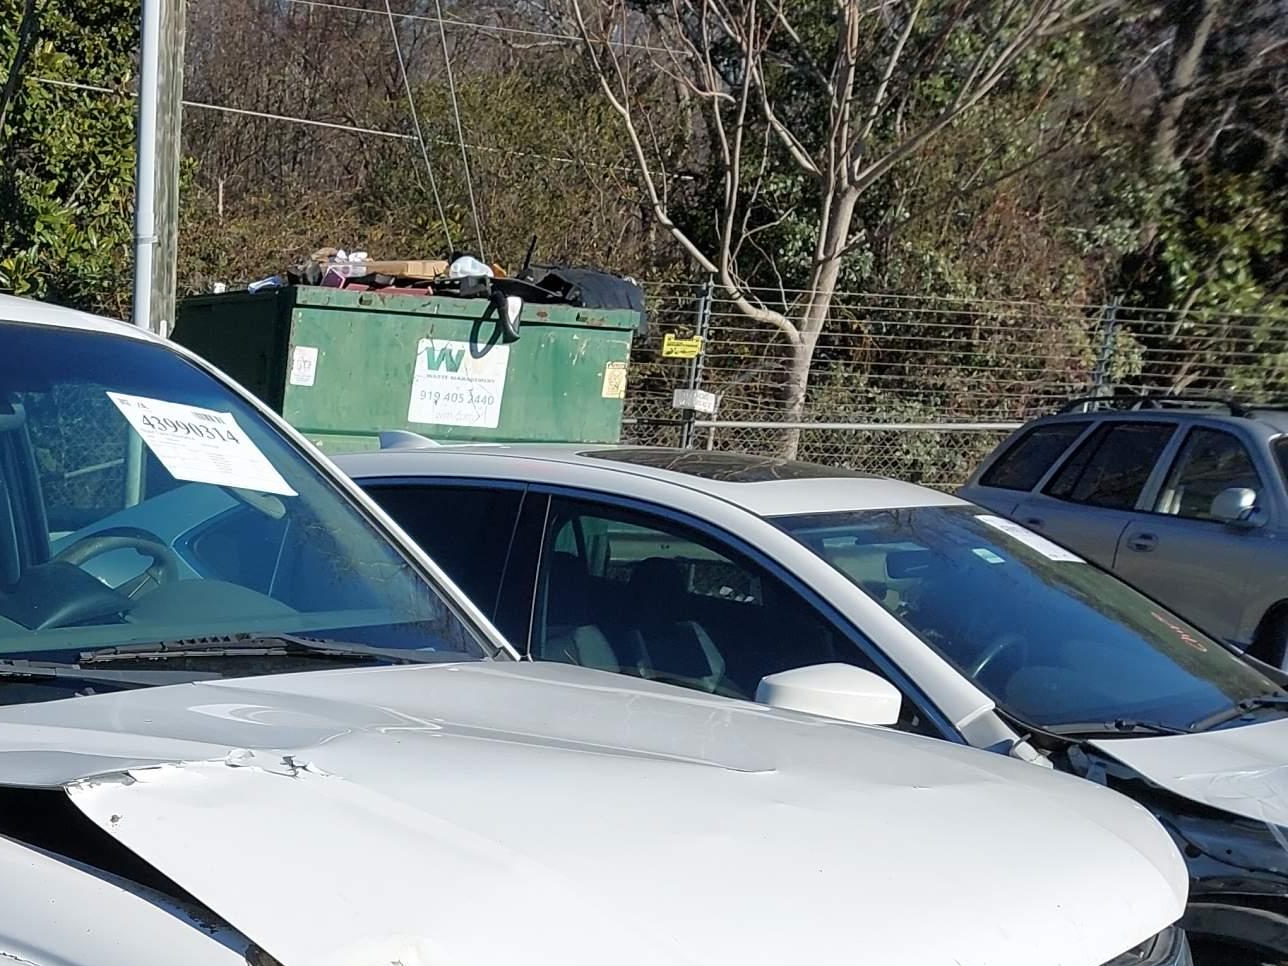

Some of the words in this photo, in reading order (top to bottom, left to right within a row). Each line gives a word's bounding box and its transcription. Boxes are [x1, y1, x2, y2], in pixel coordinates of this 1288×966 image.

[419, 390, 441, 401] 919
[443, 392, 465, 404] 405
[467, 392, 495, 406] 2440
[142, 414, 240, 444] 43990314
